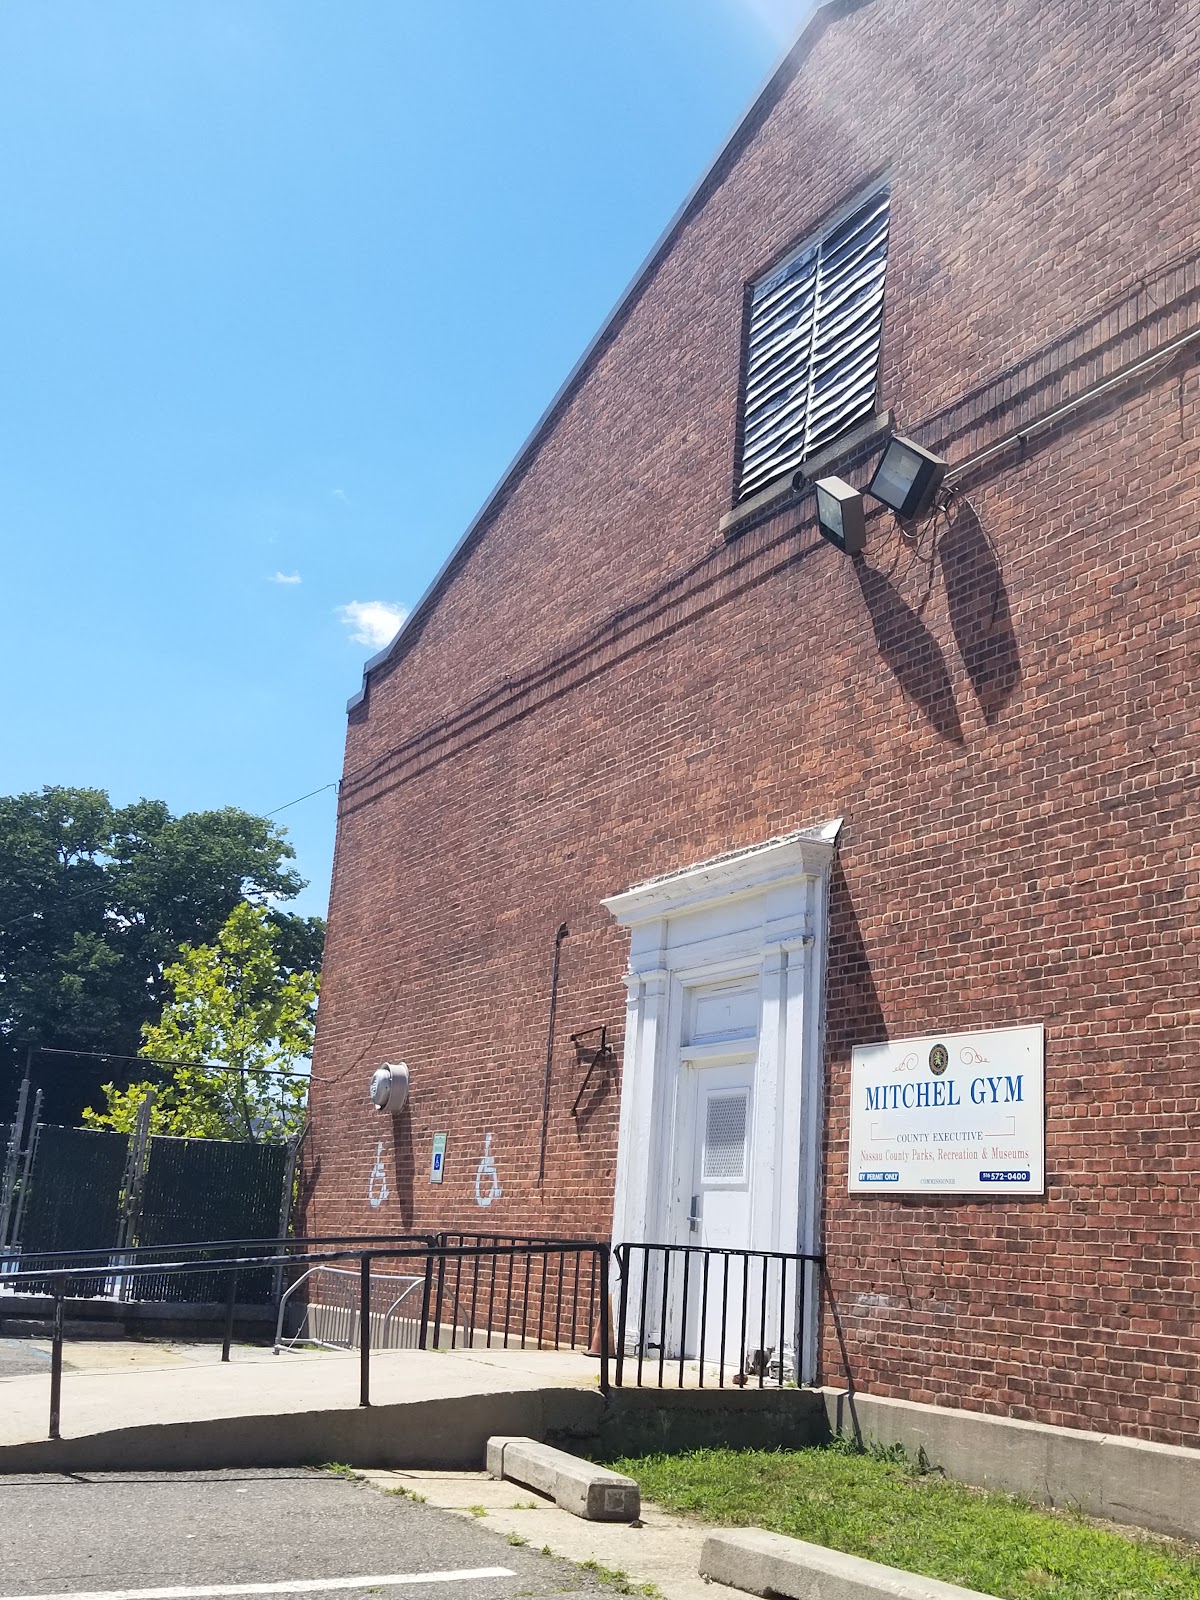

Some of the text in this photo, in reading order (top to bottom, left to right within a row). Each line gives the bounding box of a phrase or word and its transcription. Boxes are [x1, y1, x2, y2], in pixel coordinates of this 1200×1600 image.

[865, 1075, 1024, 1111] MITCHEL GYM
[897, 1131, 983, 1143] COUNTY EXECUTIVE
[861, 1147, 1029, 1163] Nassau County Parks, Recreation & Museums
[990, 1172, 1027, 1180] 572-0400
